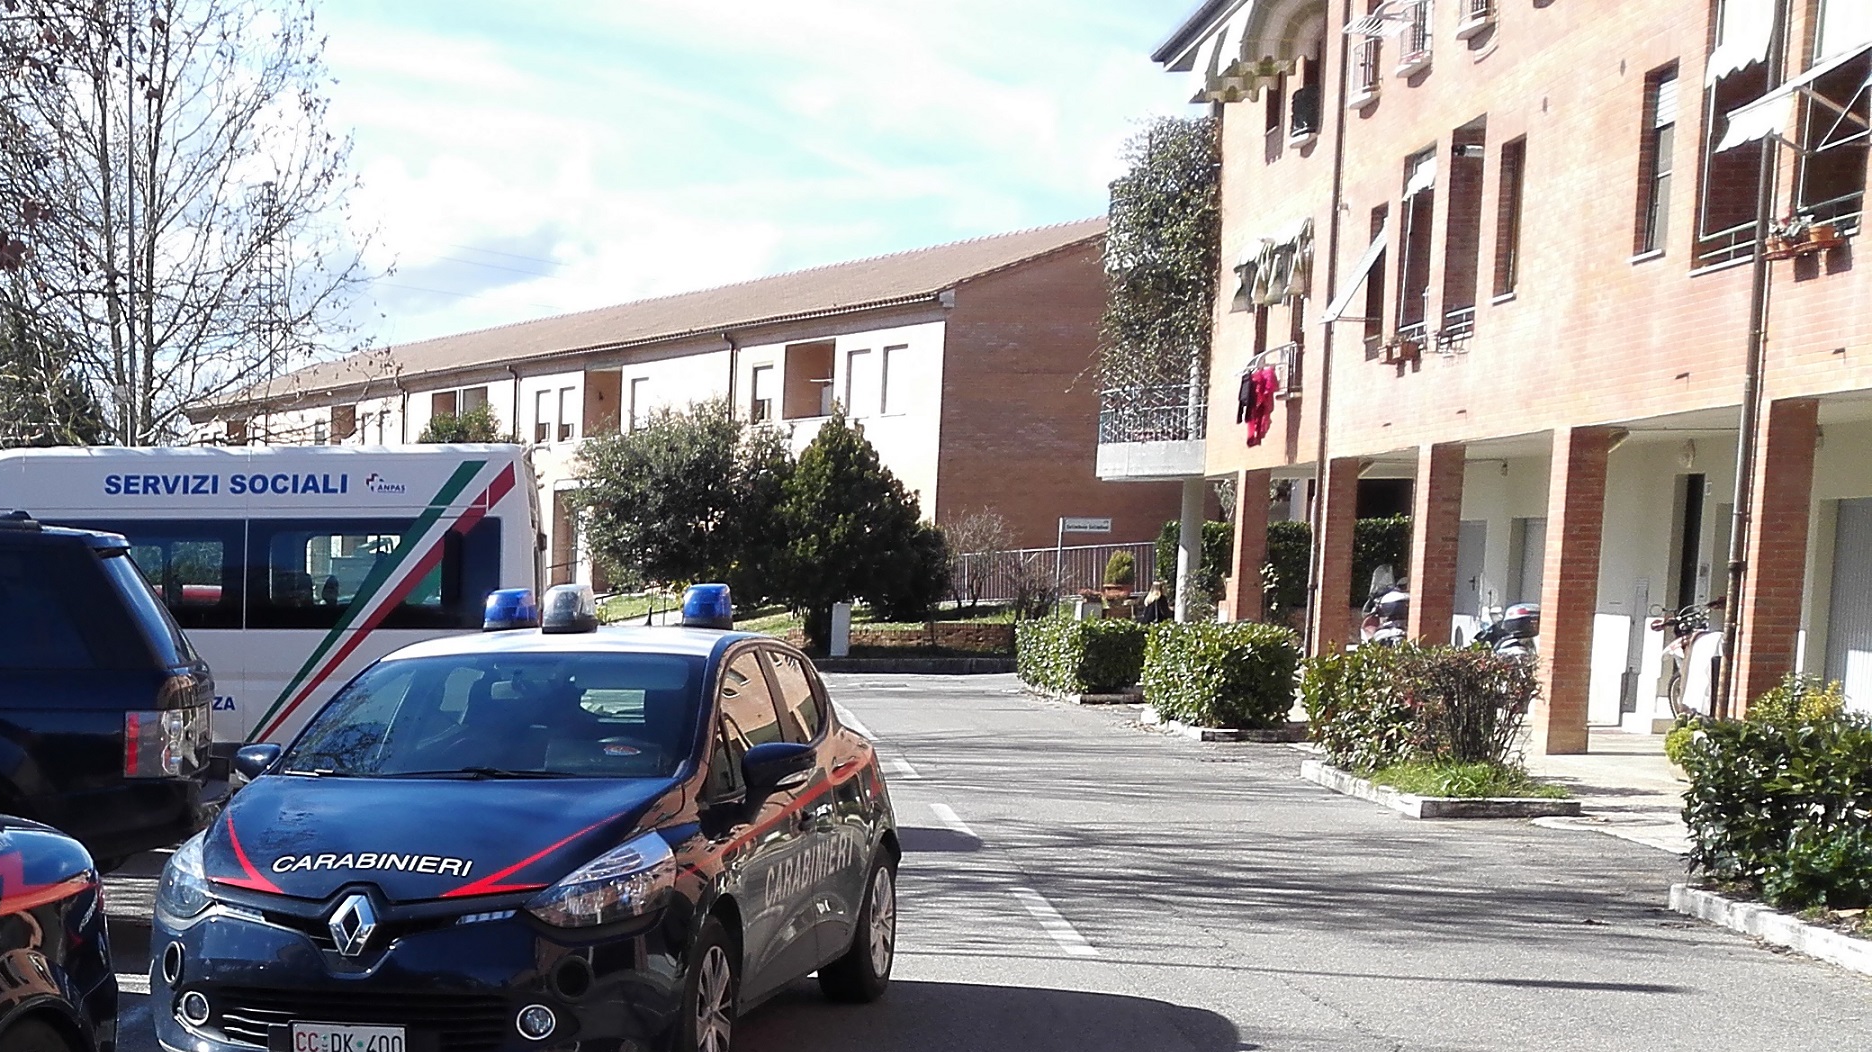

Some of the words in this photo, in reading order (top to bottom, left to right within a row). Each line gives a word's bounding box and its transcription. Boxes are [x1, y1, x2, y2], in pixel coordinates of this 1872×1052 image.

[104, 474, 218, 495] SERVIZI
[229, 473, 348, 494] SOCIALI
[212, 696, 236, 711] ZA
[271, 853, 473, 877] CARABINIERI
[765, 829, 854, 907] CARABINIERI
